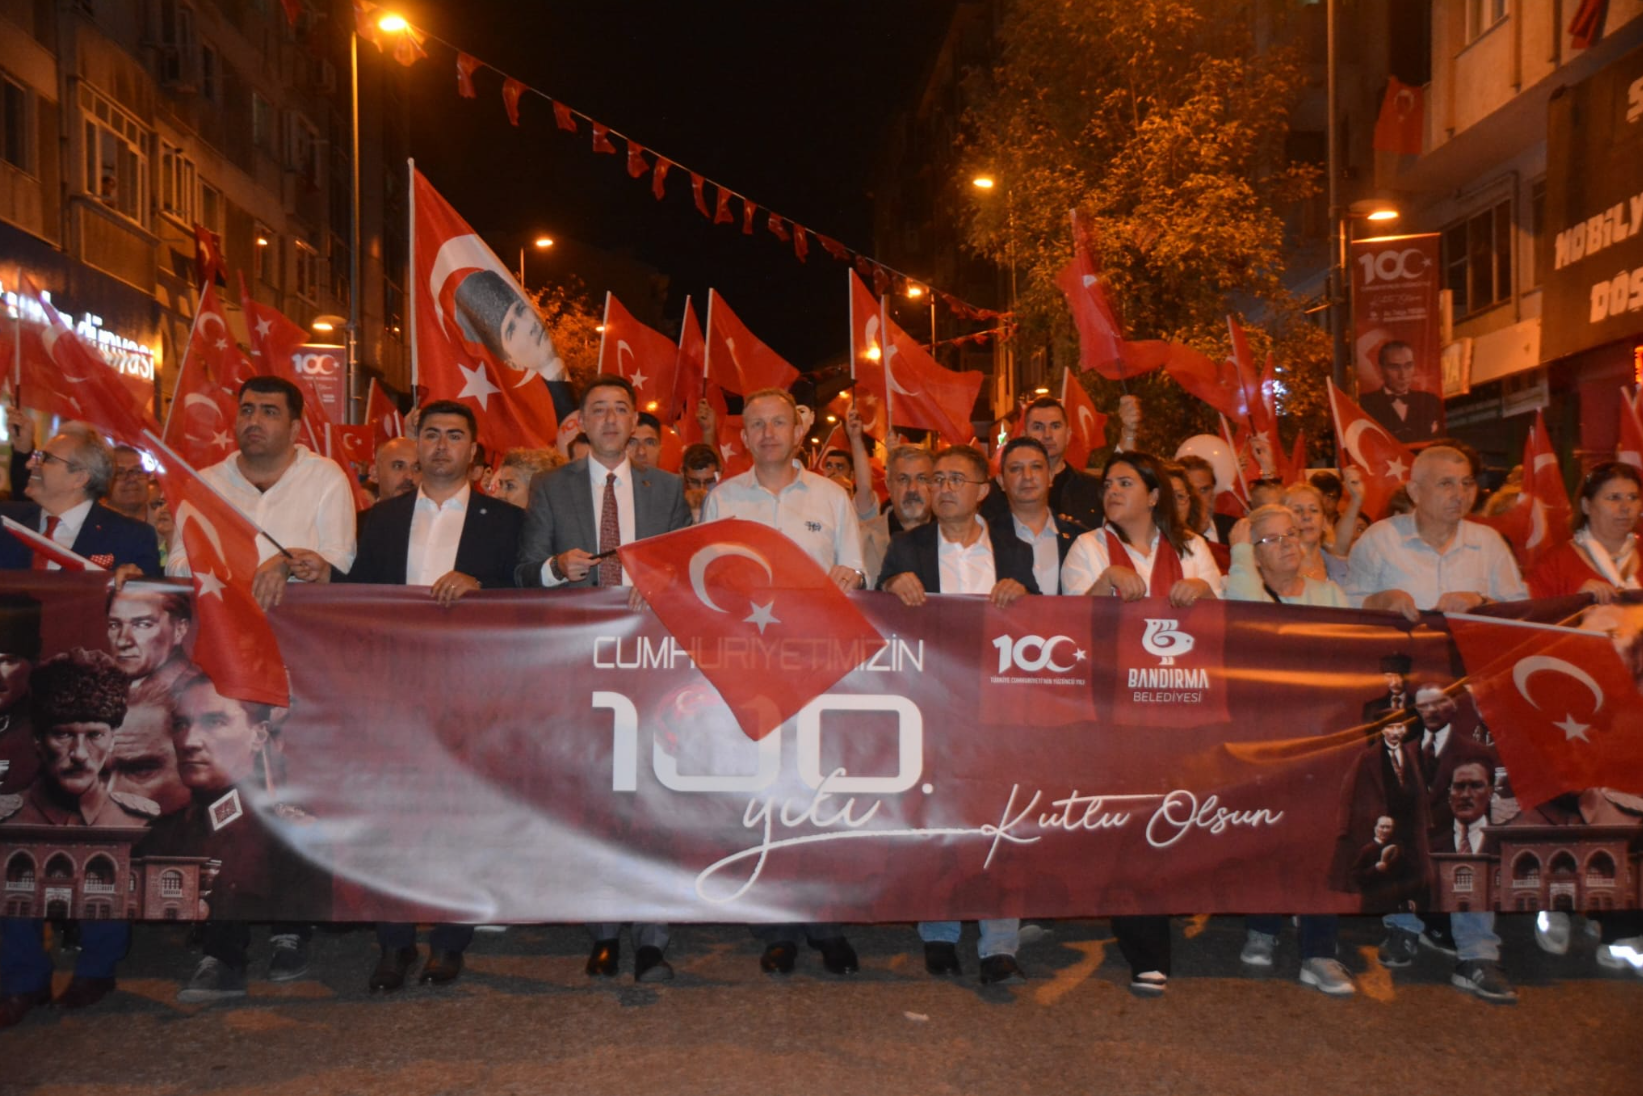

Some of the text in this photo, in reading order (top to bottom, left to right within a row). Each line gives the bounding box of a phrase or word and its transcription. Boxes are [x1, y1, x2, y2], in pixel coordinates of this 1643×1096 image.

[1358, 248, 1426, 285] 100
[992, 634, 1077, 674] 100
[1128, 668, 1209, 689] BANDIRMA
[1133, 690, 1203, 703] BELEDİYESİ
[981, 784, 1136, 869] Kutlu
[1145, 790, 1284, 847] Olsun
